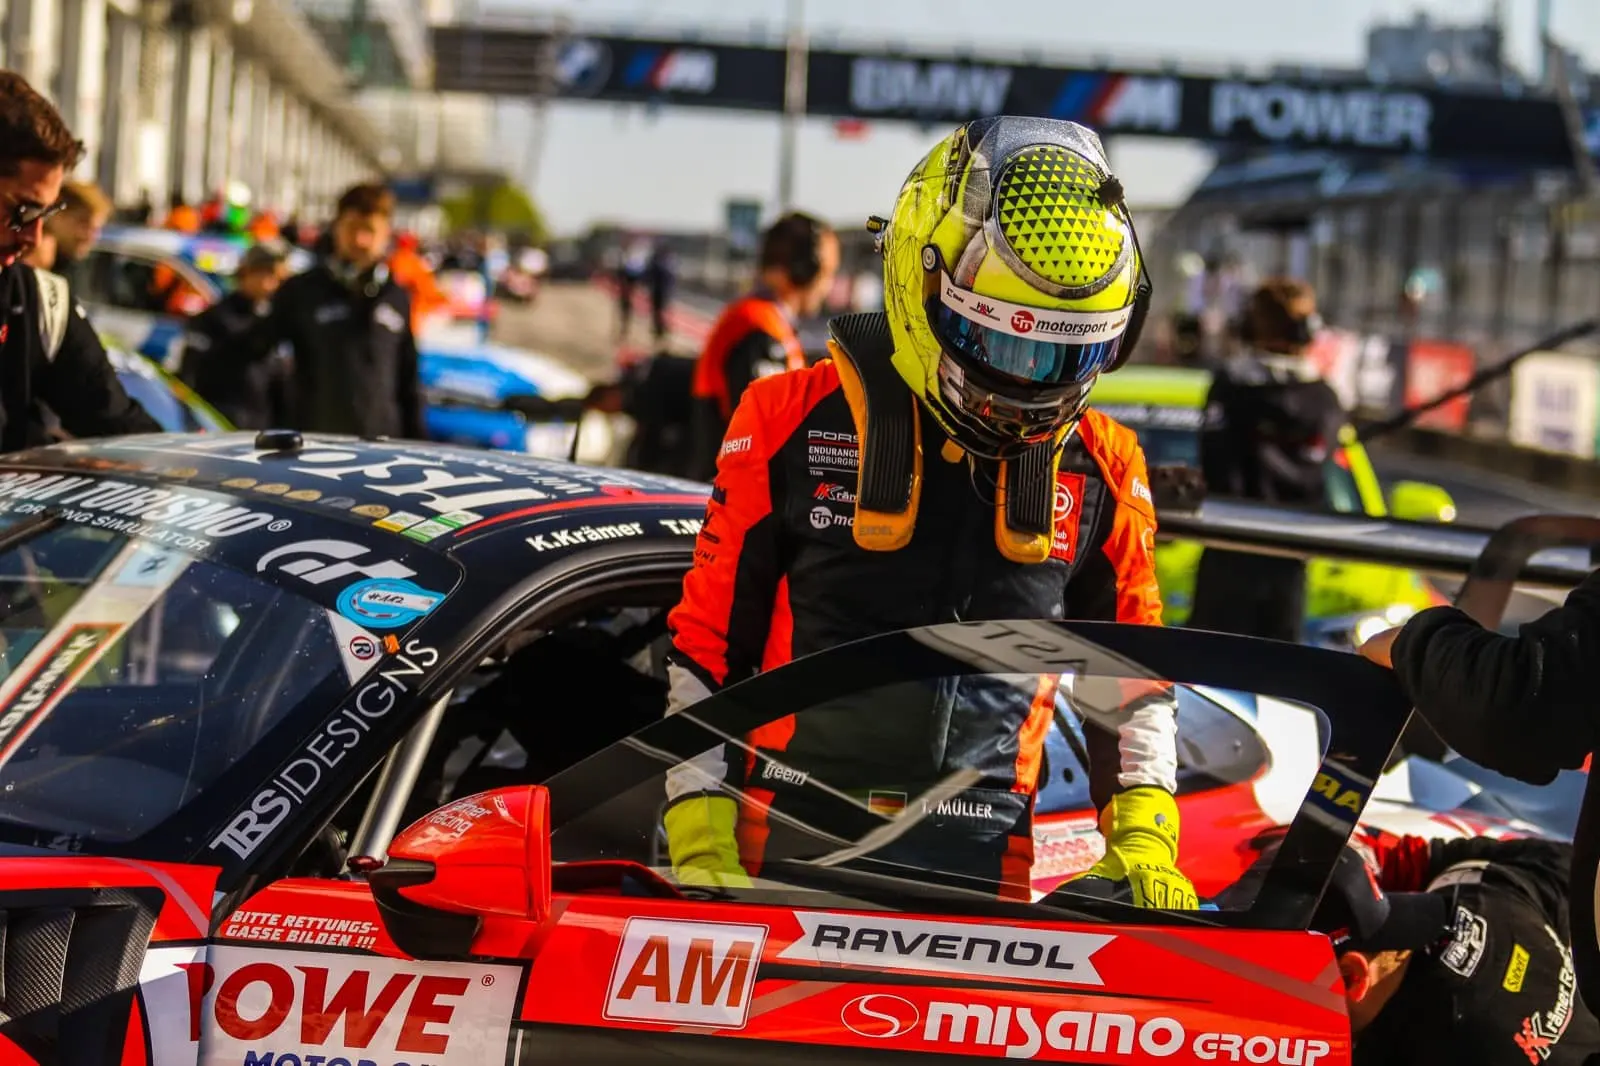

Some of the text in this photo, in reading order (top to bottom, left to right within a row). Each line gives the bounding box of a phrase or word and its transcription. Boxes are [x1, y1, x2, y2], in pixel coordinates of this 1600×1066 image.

[1210, 81, 1433, 149] POWER
[1036, 319, 1108, 337] motorsport
[808, 430, 860, 443] PORS
[808, 454, 860, 467] NÜRBURGRI
[60, 481, 274, 537] TURISMO
[91, 515, 211, 551] SIMULATOR
[525, 518, 703, 552] K.Krämer T.M
[762, 760, 809, 786] freem
[936, 798, 993, 819] MÜLLER
[226, 925, 284, 941] GASSE
[286, 929, 352, 948] BILDEN
[231, 910, 380, 934] BITTE RETTUNGS-
[812, 924, 1075, 971] RAVENOL
[616, 935, 755, 1008] AM
[1192, 1032, 1331, 1066] GROUP
